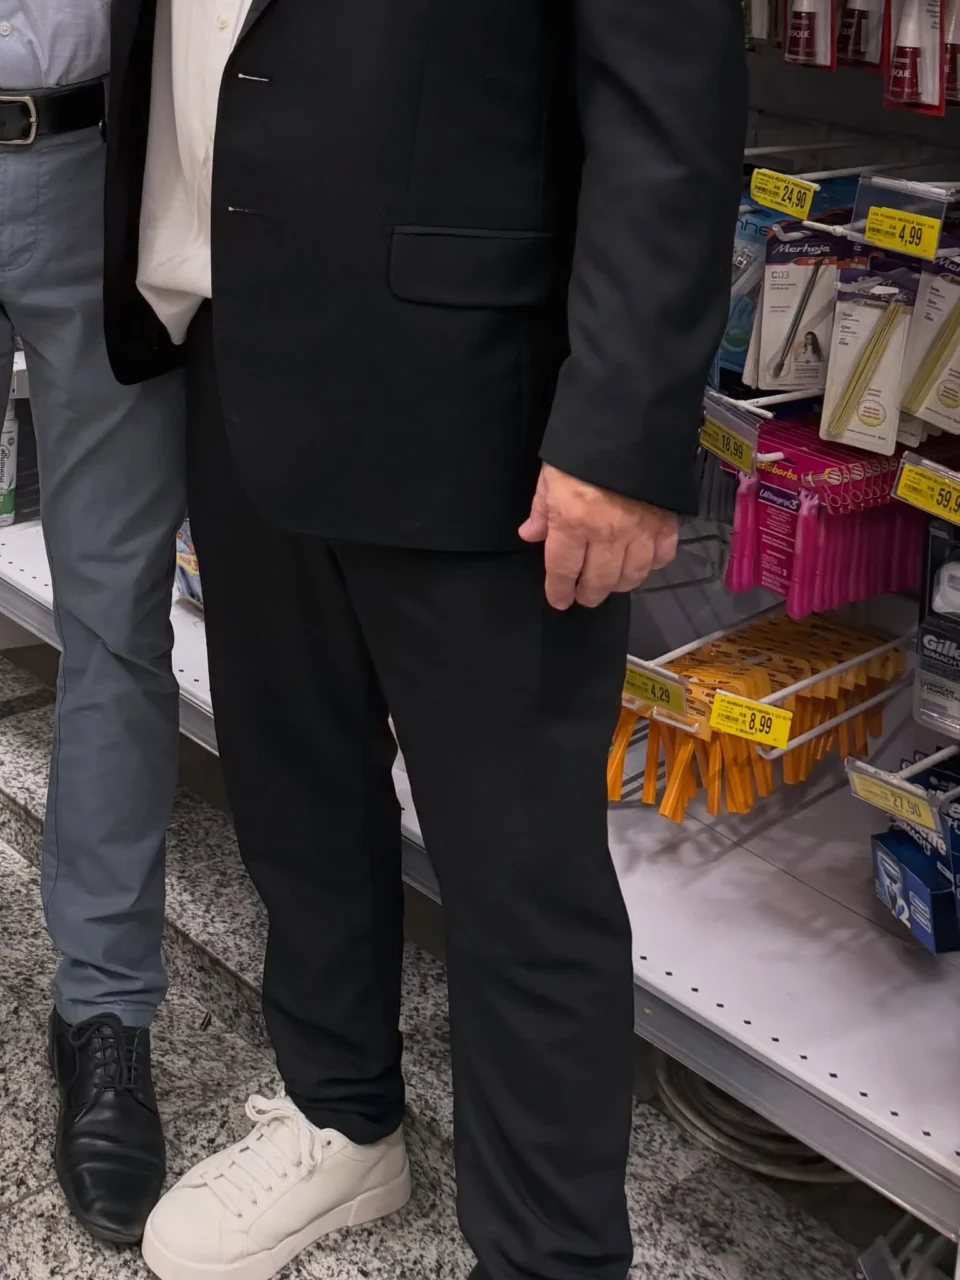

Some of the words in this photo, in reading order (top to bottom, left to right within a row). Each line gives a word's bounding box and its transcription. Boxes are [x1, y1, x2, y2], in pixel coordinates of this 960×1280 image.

[781, 185, 807, 209] 24,90
[898, 224, 923, 247] 4,99
[772, 243, 831, 254] Merheje
[721, 434, 744, 460] 18,99
[650, 683, 671, 704] 4,29
[748, 713, 773, 735] 8,99
